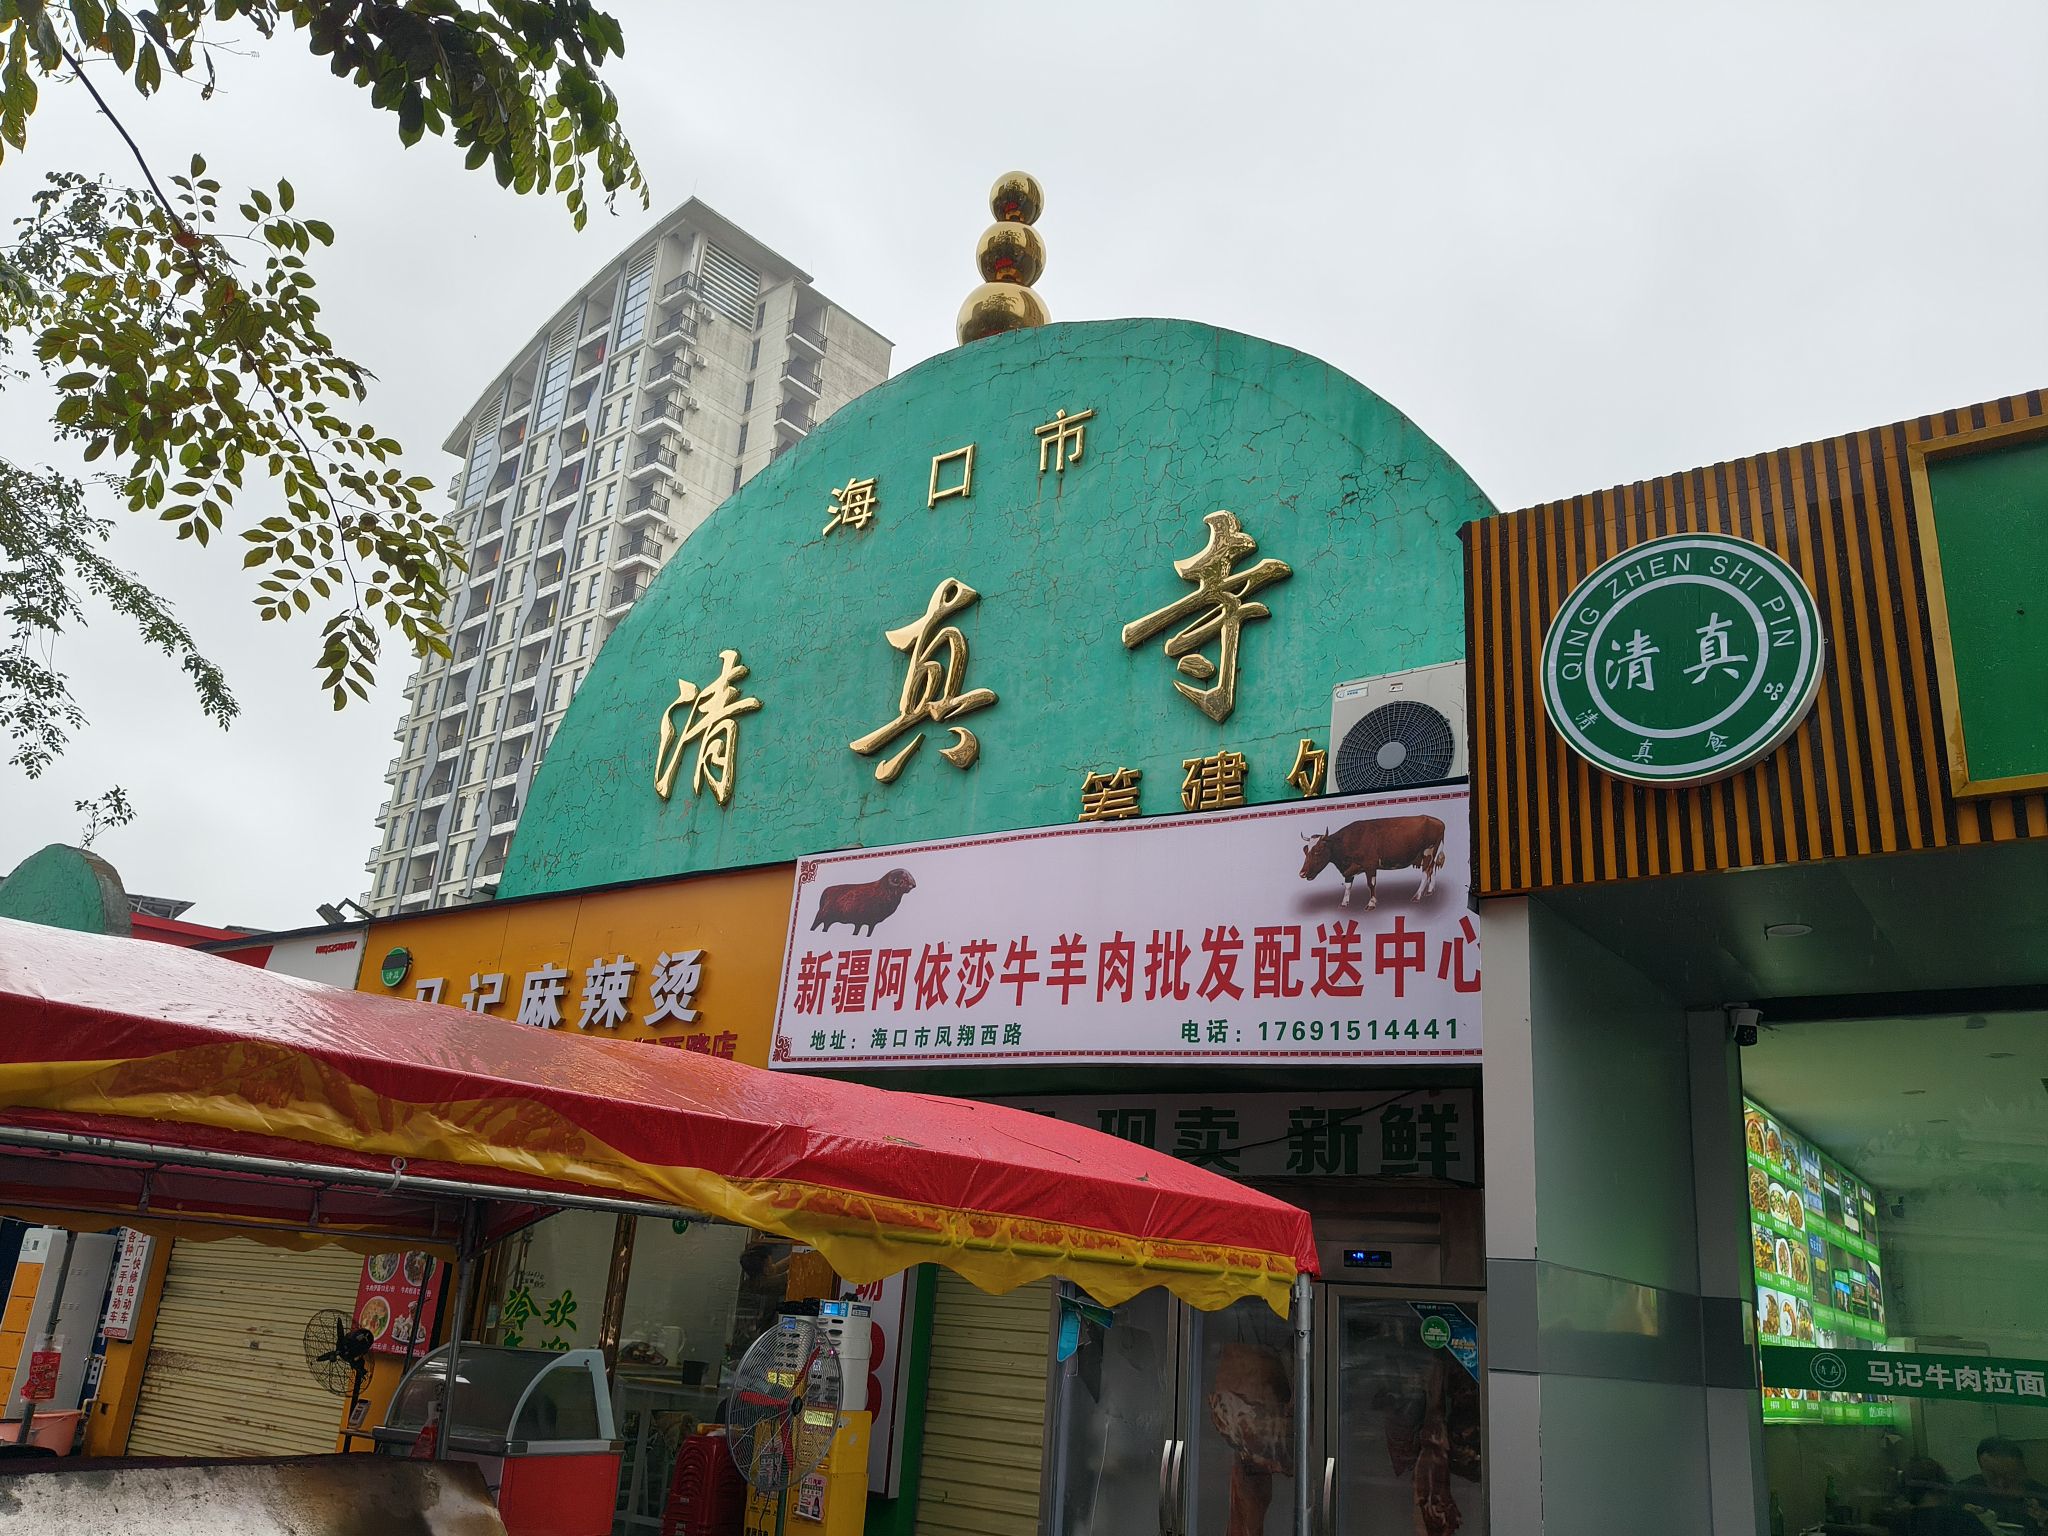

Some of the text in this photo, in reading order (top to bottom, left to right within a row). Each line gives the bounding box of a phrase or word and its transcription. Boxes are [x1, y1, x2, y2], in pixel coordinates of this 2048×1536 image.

[823, 409, 1094, 537] 海口市
[653, 509, 1293, 807] 清真寺
[1561, 553, 1795, 681] QING ZHEN SHI PIN
[1604, 612, 1749, 692] 清真
[793, 915, 1482, 1016] 新疆阿依莎牛羊肉批发配送中心
[1286, 1103, 1461, 1179] 新鲜
[109, 1231, 137, 1323] 各种二手电动车
[120, 1232, 148, 1324] 上门快修电动车
[1867, 1359, 2047, 1397] 马记牛肉拉面
